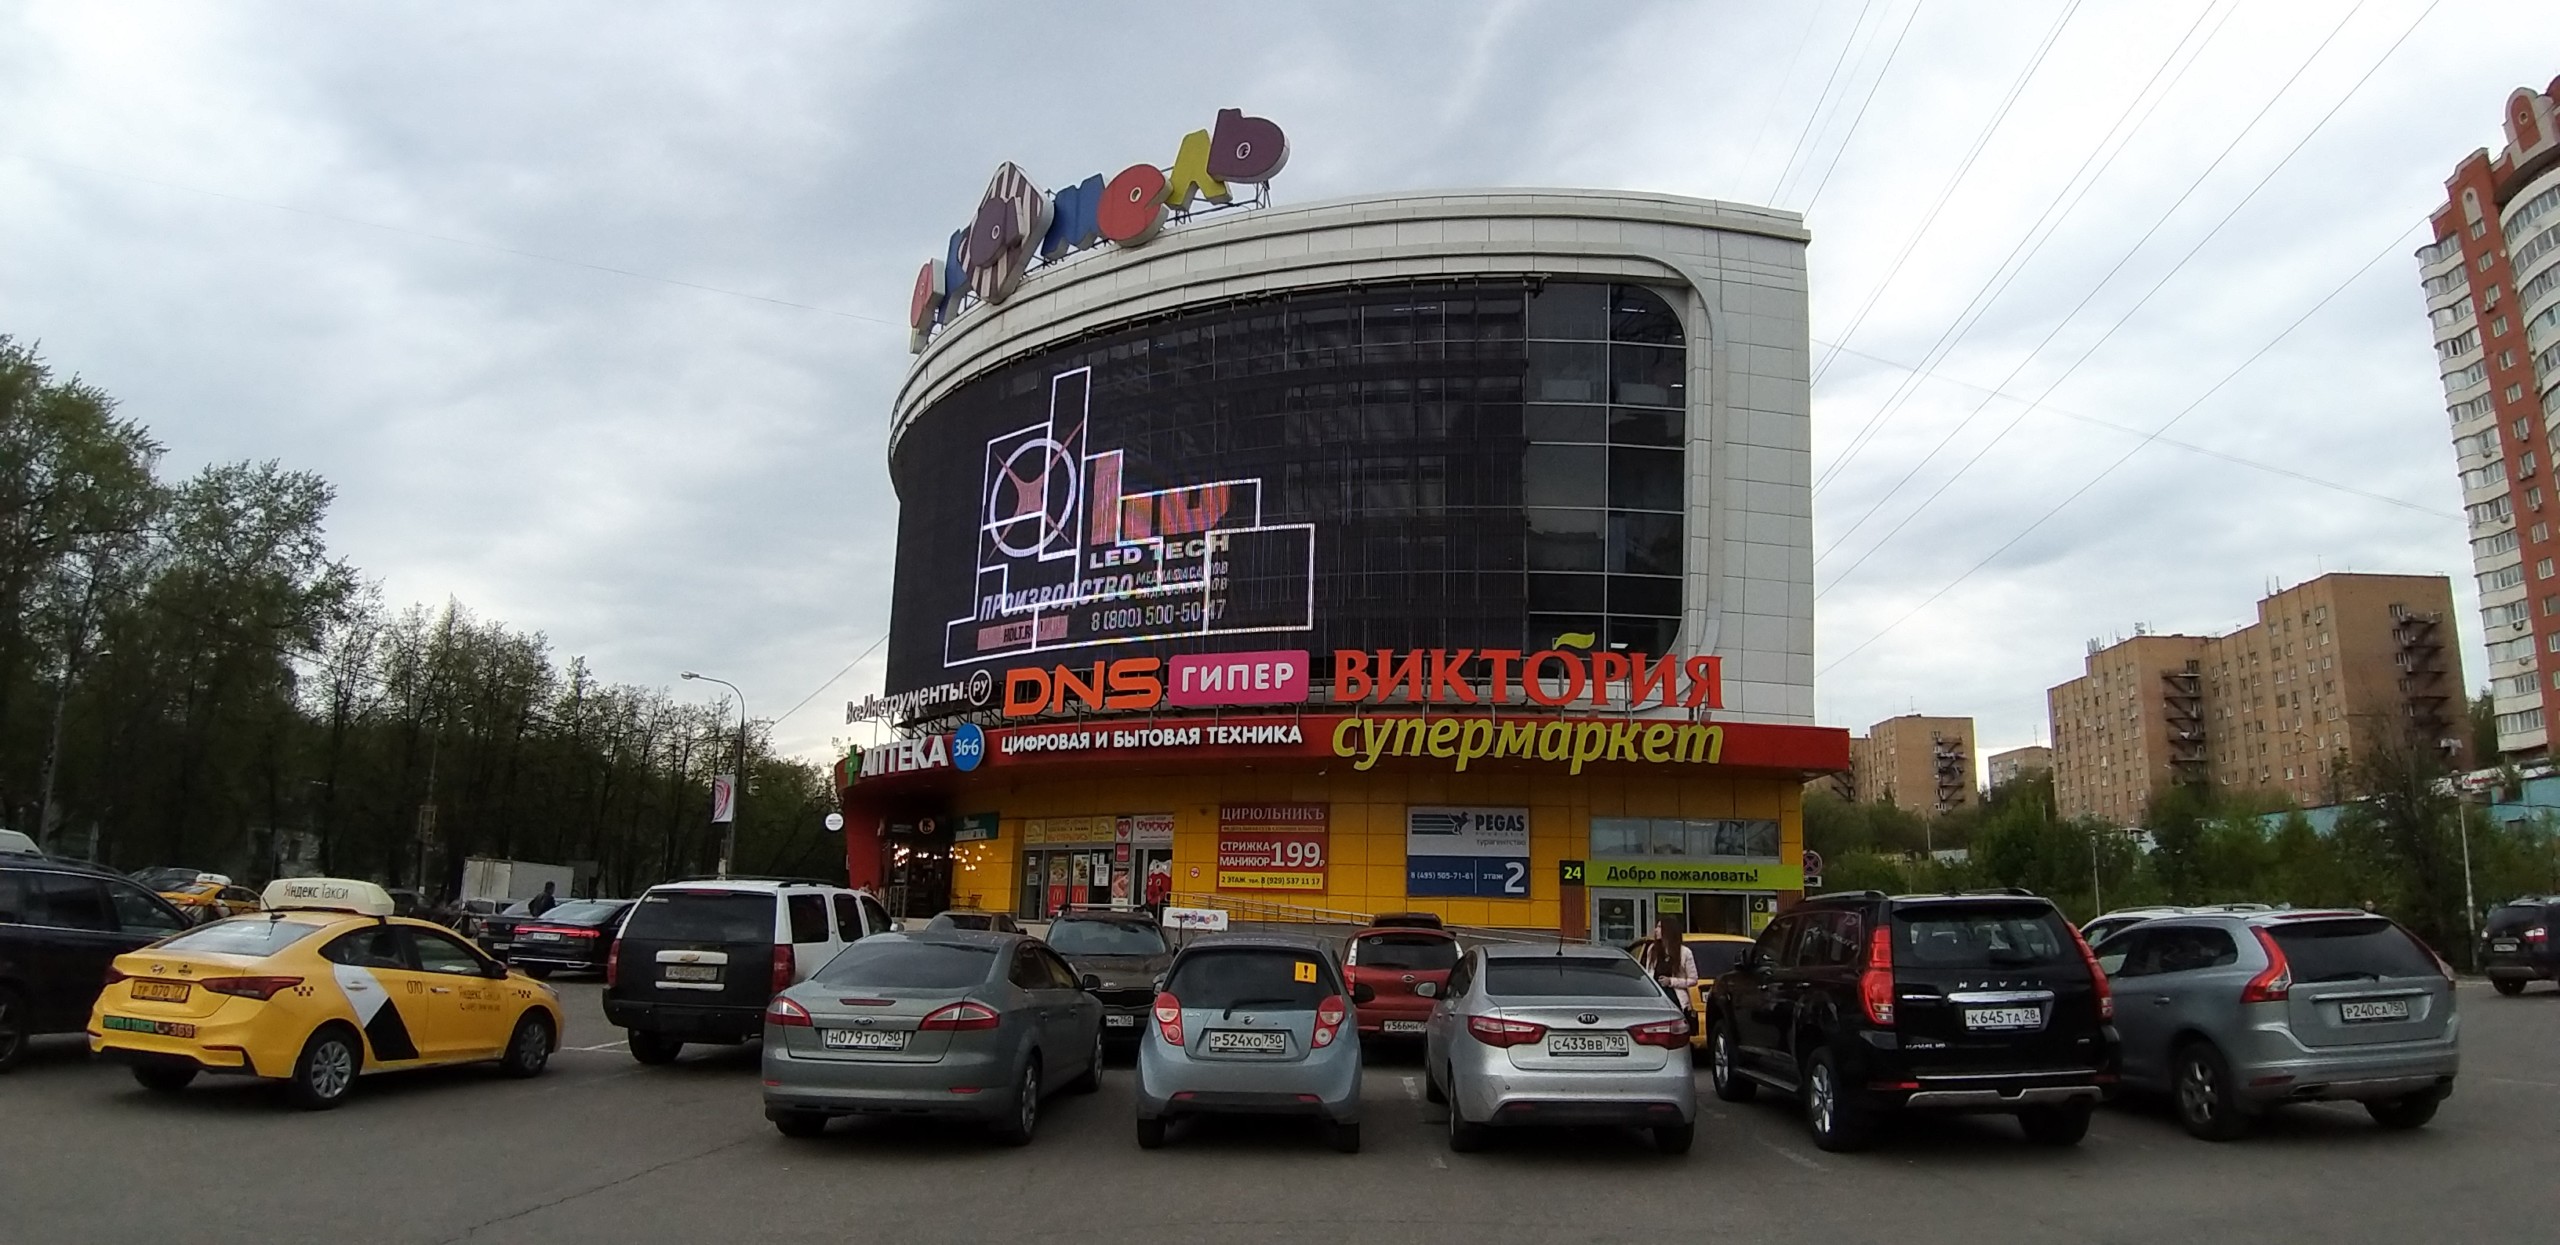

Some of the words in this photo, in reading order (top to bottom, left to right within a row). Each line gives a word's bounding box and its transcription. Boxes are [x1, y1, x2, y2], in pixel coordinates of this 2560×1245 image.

[1089, 546, 1142, 569] LED
[1149, 533, 1230, 562] TECH
[980, 574, 1134, 623] ПРОИЗВОДСТВО
[1091, 612, 1100, 631] 8
[1103, 606, 1142, 630] (800)
[1003, 657, 1162, 716] DNS
[1181, 662, 1294, 692] ГИПЕР
[1334, 648, 1725, 709] ВИКТОРИЯ
[1001, 732, 1090, 755] ЦИФРОВАЯ
[1095, 732, 1108, 749] И
[1113, 727, 1201, 748] БЫТОВАЯ
[1206, 725, 1303, 745] ТЕХНИКА
[1332, 717, 1724, 775] супермаркет
[860, 735, 949, 778] АПТЕКА
[1221, 807, 1325, 821] ЦИРЮЛЬНИКЪ
[1475, 814, 1525, 831] PEGAS
[1220, 842, 1270, 852] СТРИЖКА
[1220, 857, 1270, 867] МАНИКЮР
[1286, 877, 1299, 885] 537
[1504, 862, 1525, 893] 2
[1563, 866, 1581, 880] 24
[1606, 866, 1656, 881] Добро
[1660, 868, 1758, 882] пожаловать!
[284, 883, 319, 899] Яндекс
[321, 883, 349, 900] Такси
[406, 981, 423, 994] 070
[1580, 1014, 1596, 1022] KIA
